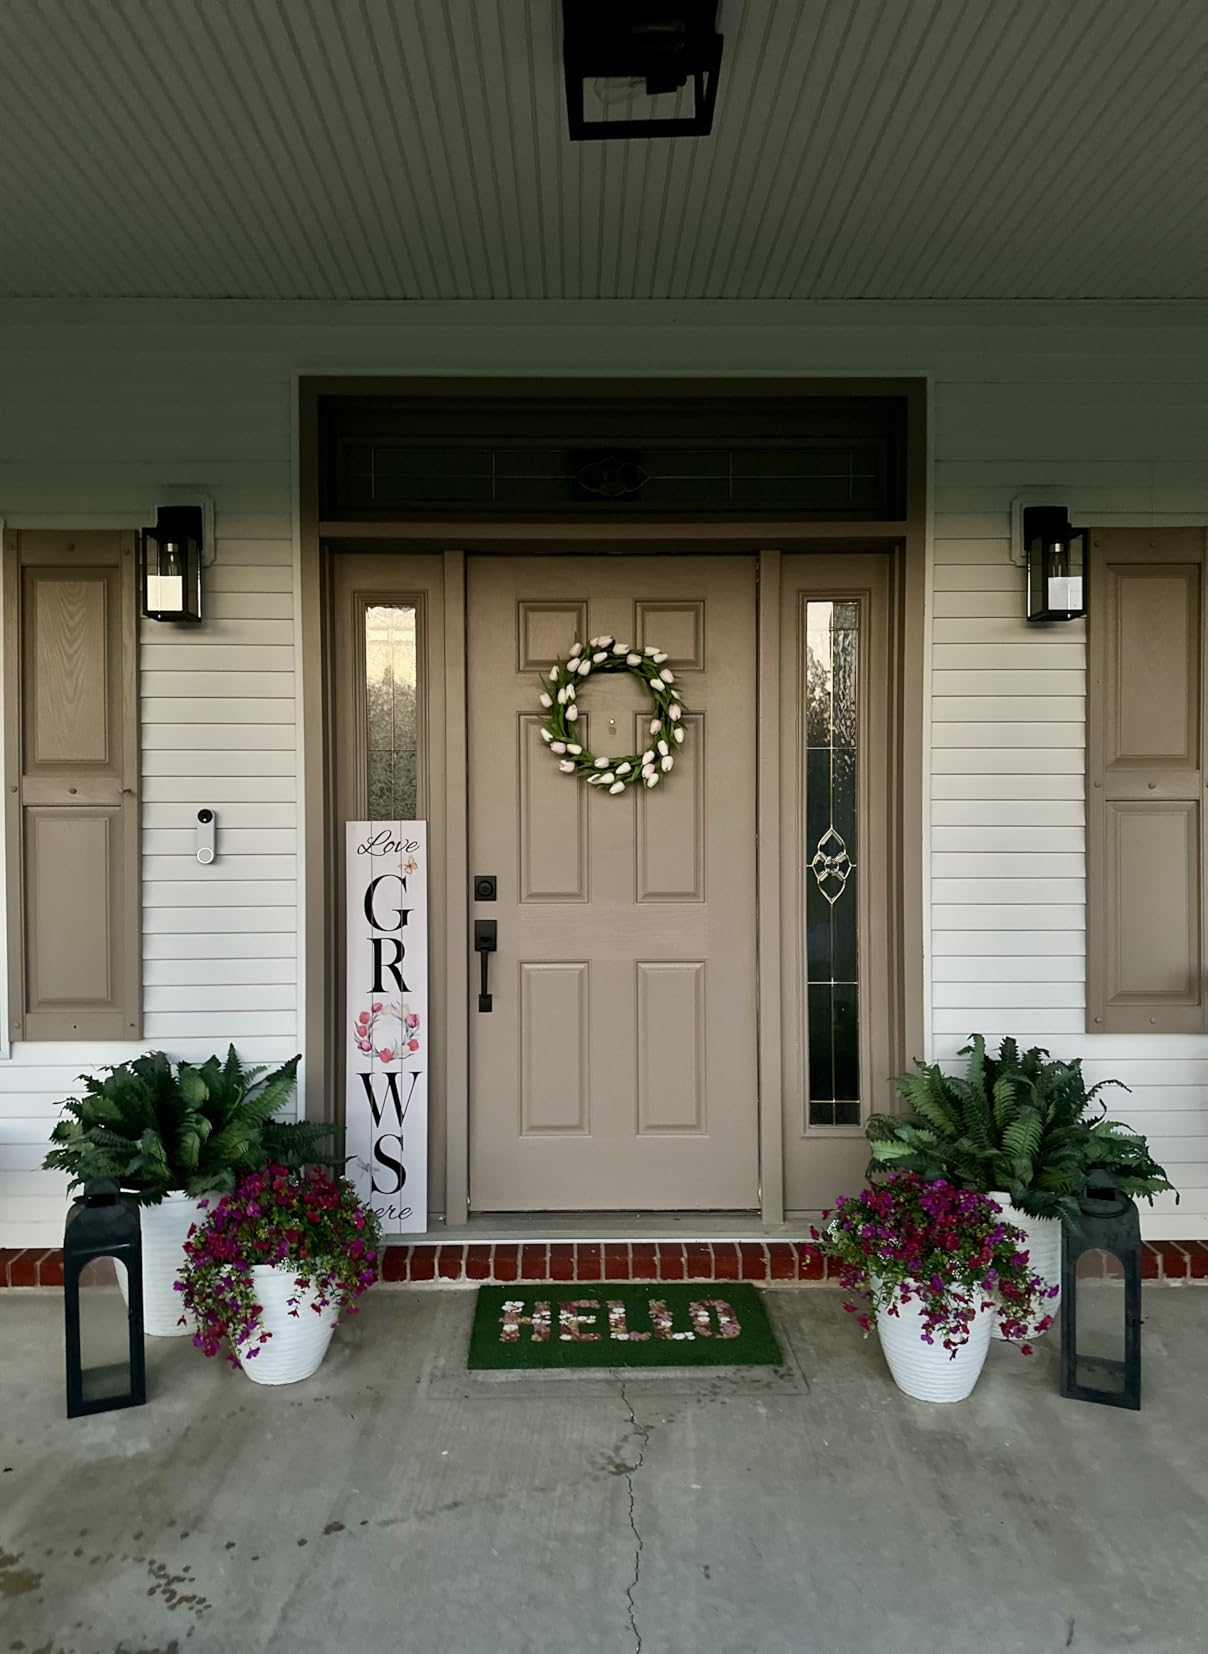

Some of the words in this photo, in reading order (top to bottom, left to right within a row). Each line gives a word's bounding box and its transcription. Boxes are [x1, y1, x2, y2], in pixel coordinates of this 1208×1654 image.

[357, 829, 420, 857] Love
[366, 1201, 413, 1220] ere
[499, 1299, 742, 1342] HELLO
